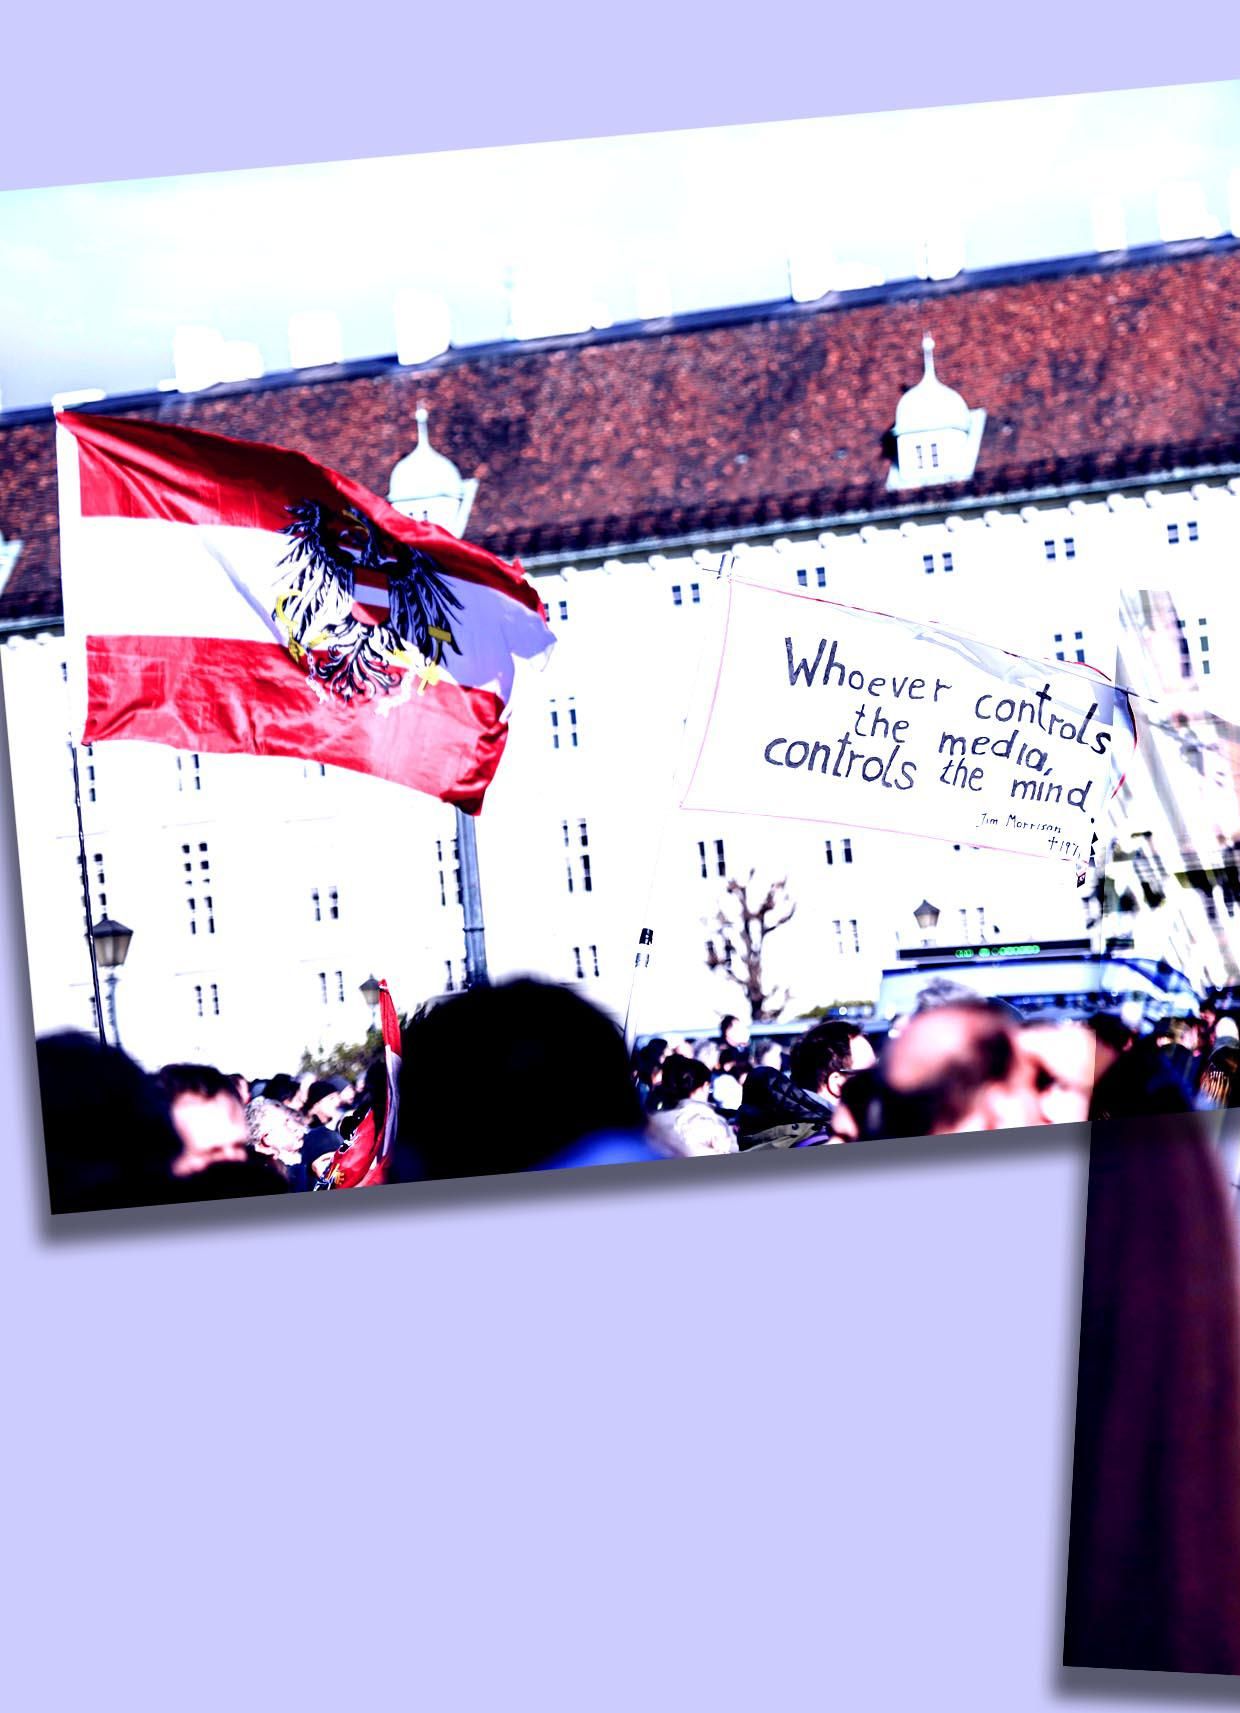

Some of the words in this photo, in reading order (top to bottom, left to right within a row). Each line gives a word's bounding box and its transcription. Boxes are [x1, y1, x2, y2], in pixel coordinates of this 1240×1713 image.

[784, 637, 952, 702] Whoever
[975, 684, 1112, 754] controls
[764, 732, 917, 790] controls
[939, 757, 984, 791] the
[854, 704, 910, 743] the
[938, 729, 1053, 776] media,
[976, 813, 998, 828] Jim
[1006, 814, 1062, 834] Morrison
